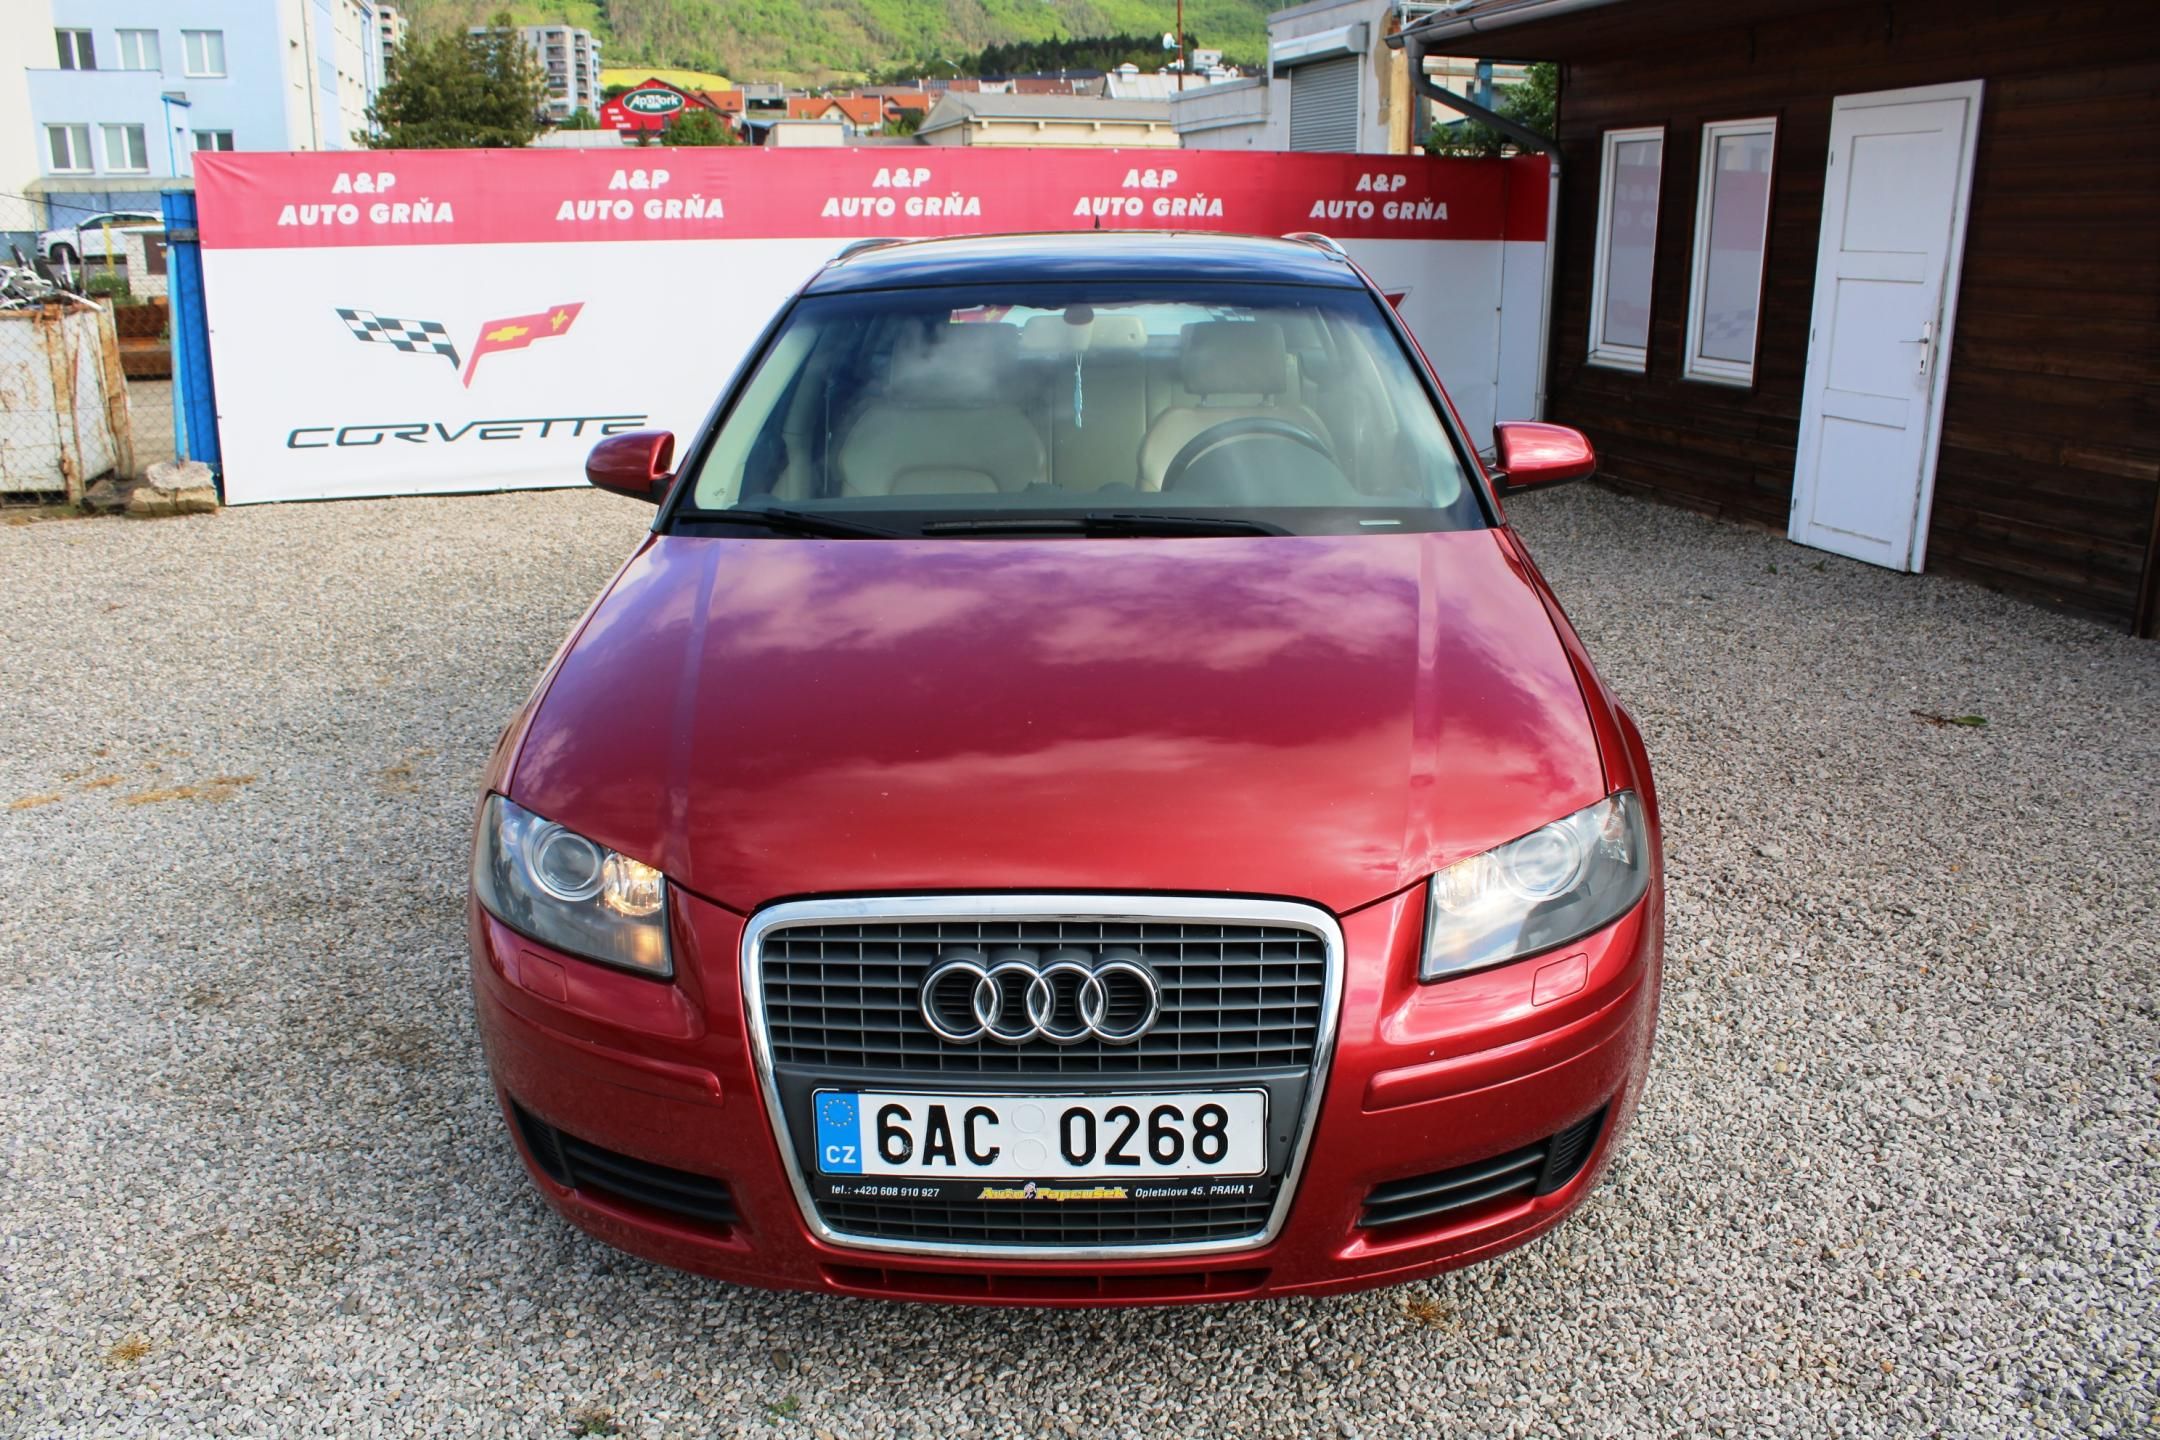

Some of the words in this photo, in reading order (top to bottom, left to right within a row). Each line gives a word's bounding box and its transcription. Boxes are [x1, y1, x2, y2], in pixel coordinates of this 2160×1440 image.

[332, 172, 396, 194] A&P
[608, 169, 670, 191] A&P
[871, 167, 931, 188] A&P
[1122, 168, 1178, 188] A&P
[1355, 174, 1407, 192] A&P
[277, 203, 360, 226] AUTO
[369, 198, 454, 225] GRŇA
[555, 199, 634, 221] AUTO
[643, 193, 724, 220] GRŇA
[821, 197, 896, 217] AUTO
[904, 192, 981, 217] GRŇA
[1073, 196, 1144, 217] AUTO
[1152, 193, 1223, 217] GRŇA
[1309, 199, 1375, 219] AUTO
[1382, 197, 1448, 220] GRŇA
[286, 415, 648, 449] CORVETTE
[876, 1103, 1000, 1166] 6AC
[1059, 1104, 1229, 1165] 0268
[826, 1145, 856, 1164] CZ
[831, 1184, 851, 1195] tel.:
[853, 1185, 877, 1196] +420
[880, 1186, 899, 1197] 608
[900, 1187, 919, 1197] 910
[921, 1188, 940, 1197] 927
[1135, 1187, 1188, 1199] Opletalova
[1209, 1184, 1245, 1195] PRAHA
[1248, 1184, 1254, 1194] 1
